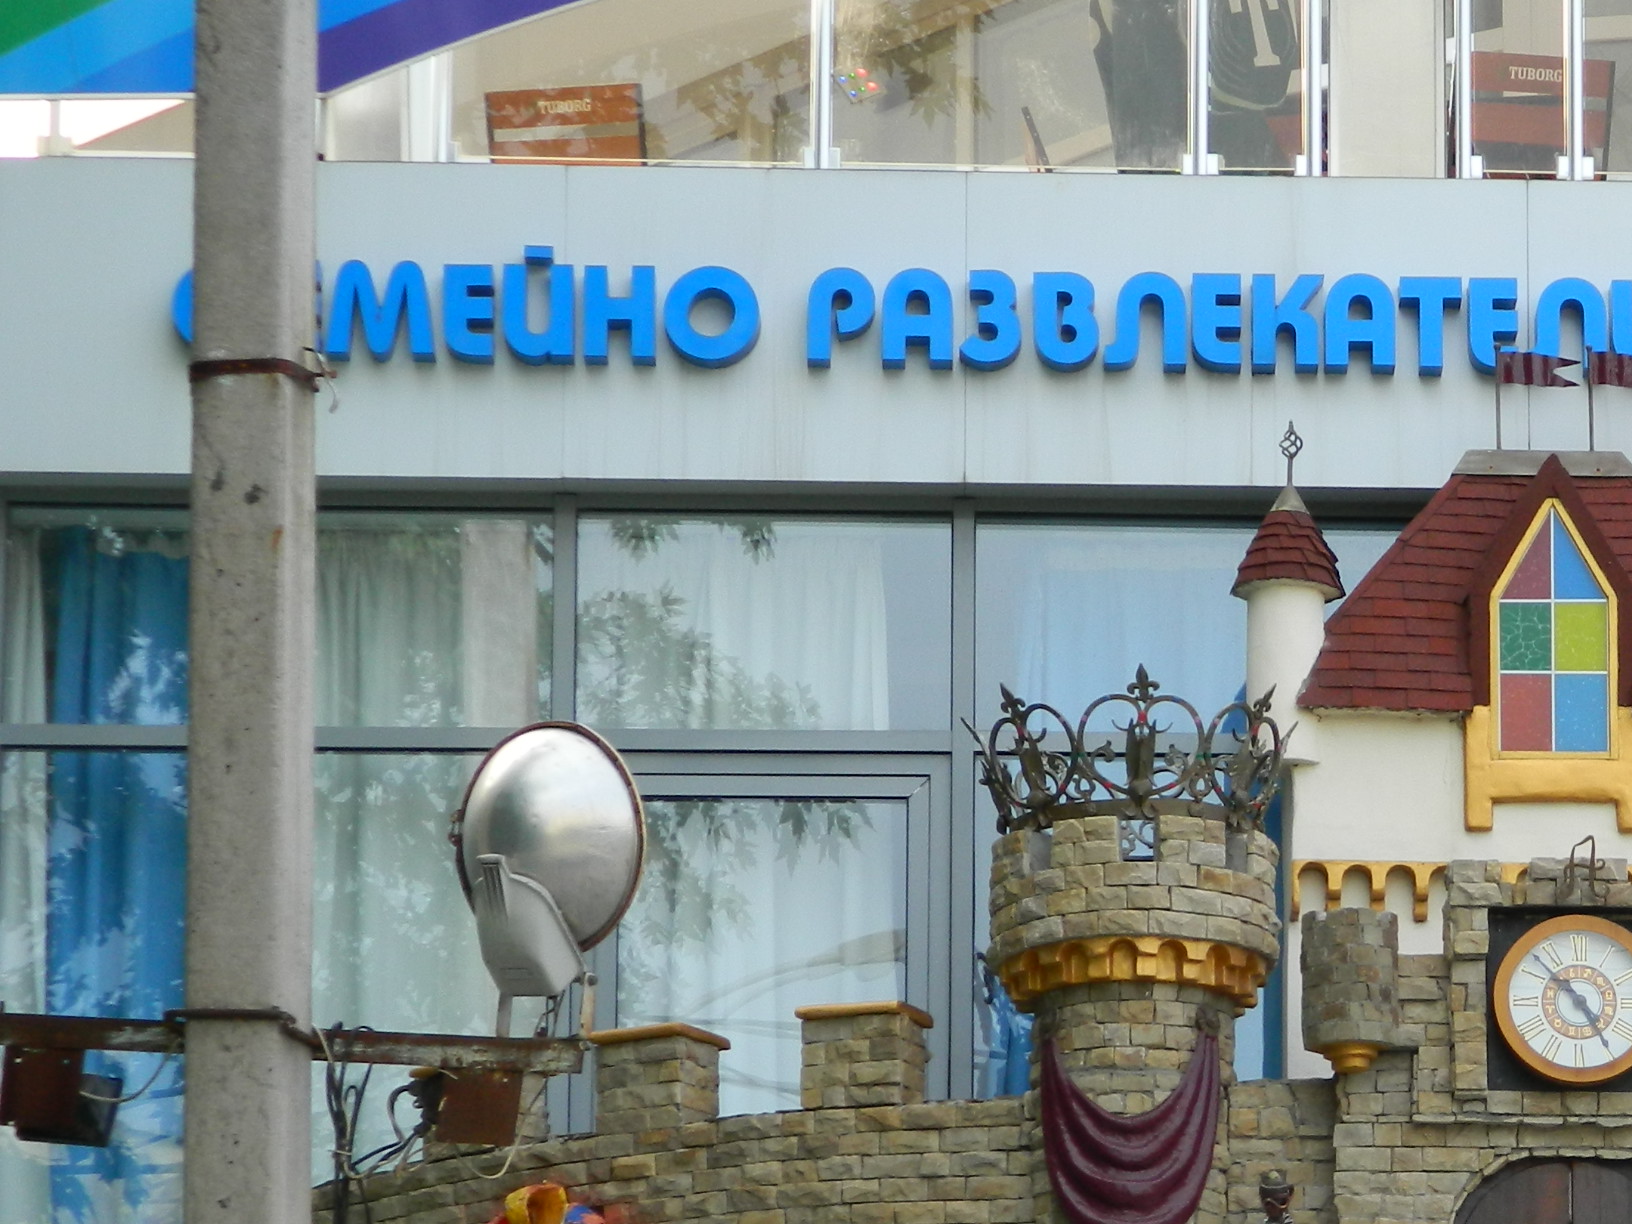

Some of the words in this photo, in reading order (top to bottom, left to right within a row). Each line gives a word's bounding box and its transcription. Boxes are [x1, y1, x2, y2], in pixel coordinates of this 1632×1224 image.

[1509, 66, 1563, 82] TUBORG
[537, 98, 592, 115] TUBORG
[172, 245, 762, 369] МЕЙНО
